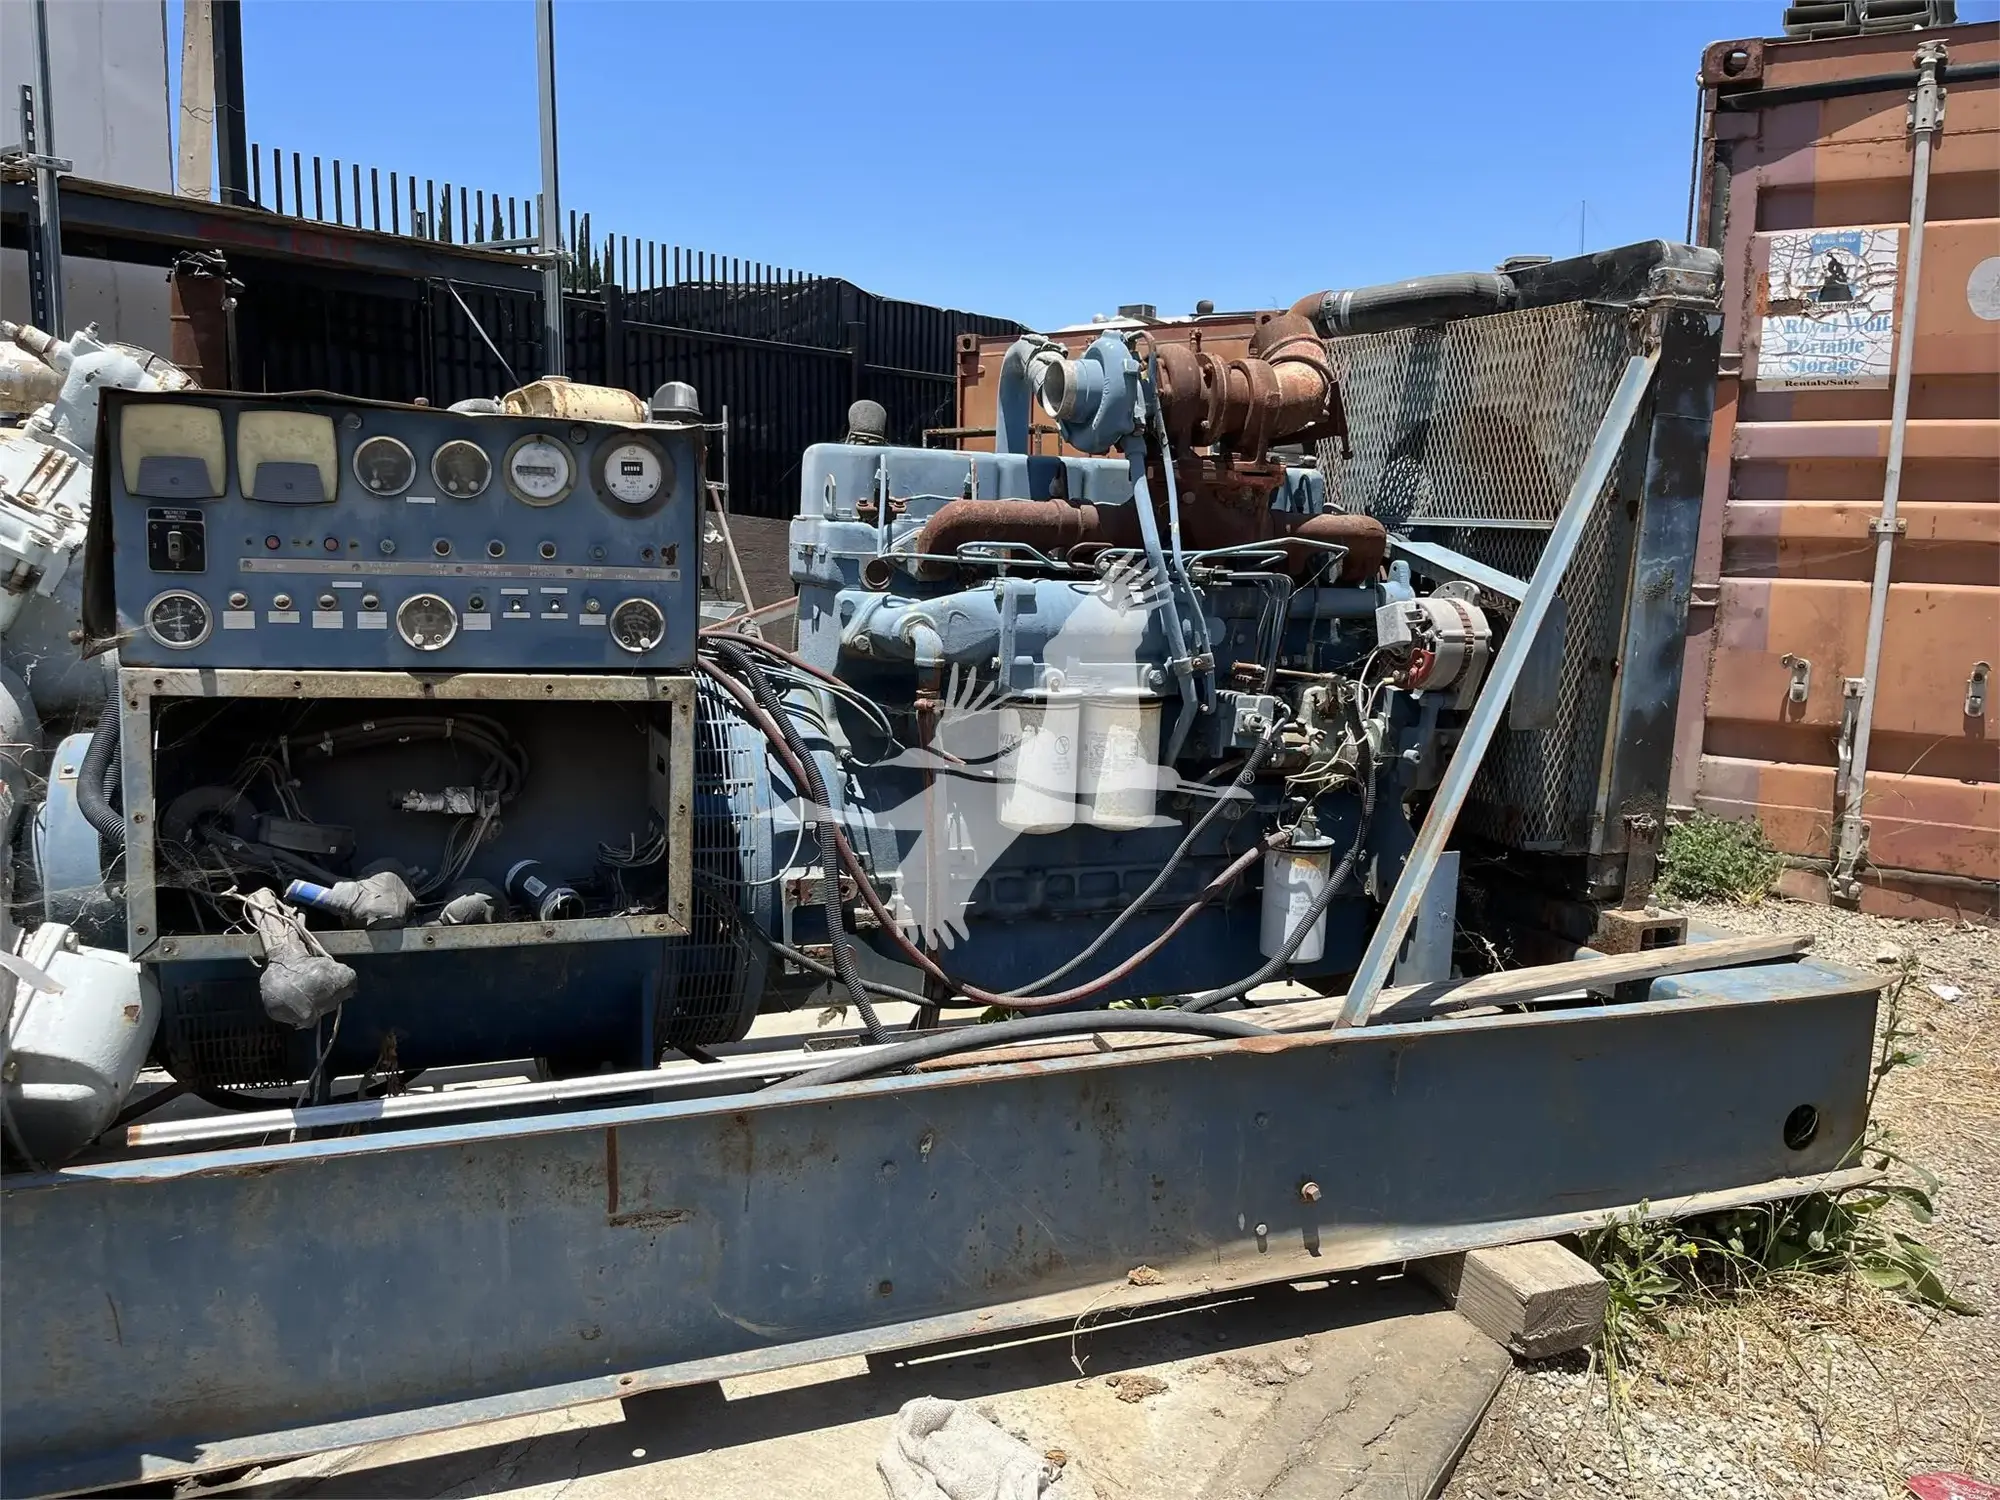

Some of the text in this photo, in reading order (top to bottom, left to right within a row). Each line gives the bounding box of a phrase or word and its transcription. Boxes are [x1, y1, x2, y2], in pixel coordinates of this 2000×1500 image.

[1785, 317, 1839, 336] Royal
[1786, 338, 1865, 354] Portable
[1787, 358, 1860, 375] Storage
